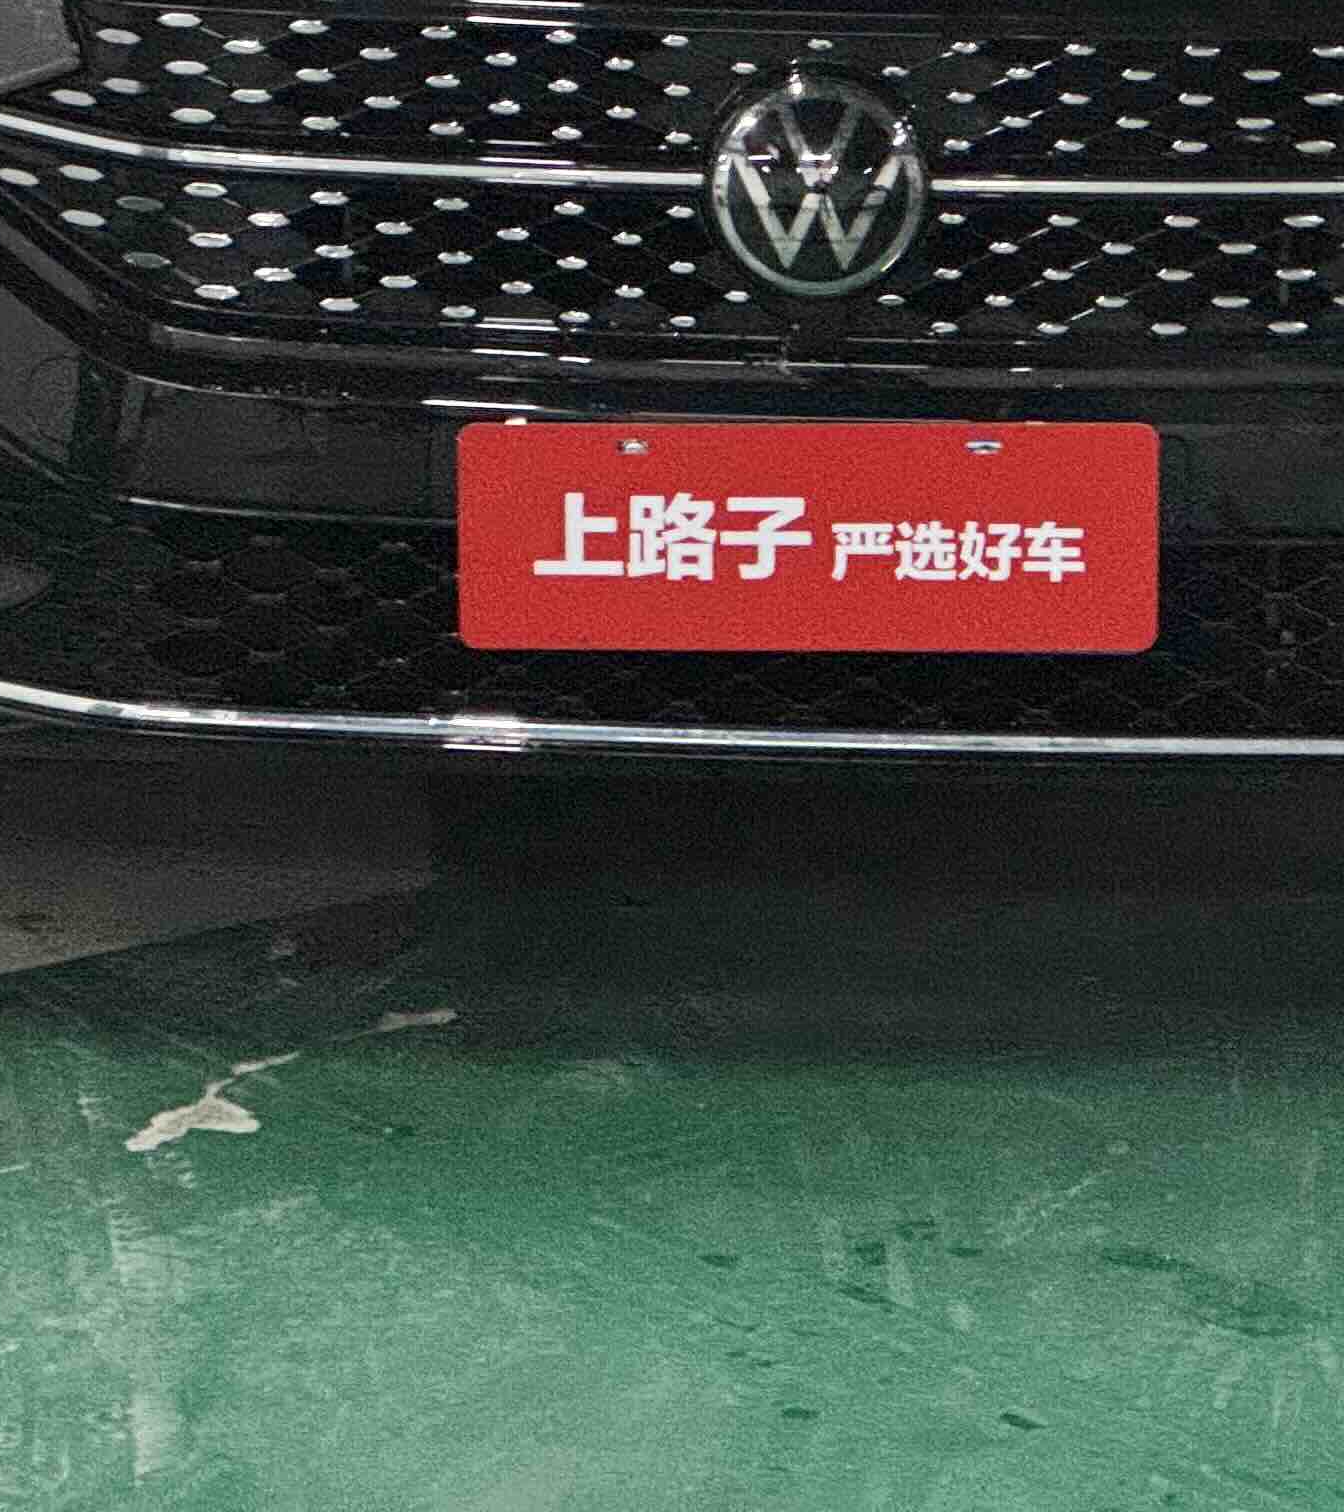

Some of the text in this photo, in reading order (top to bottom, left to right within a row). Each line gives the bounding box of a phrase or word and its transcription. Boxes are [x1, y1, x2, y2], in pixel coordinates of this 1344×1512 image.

[532, 492, 1086, 583] 上路子 严选好车
